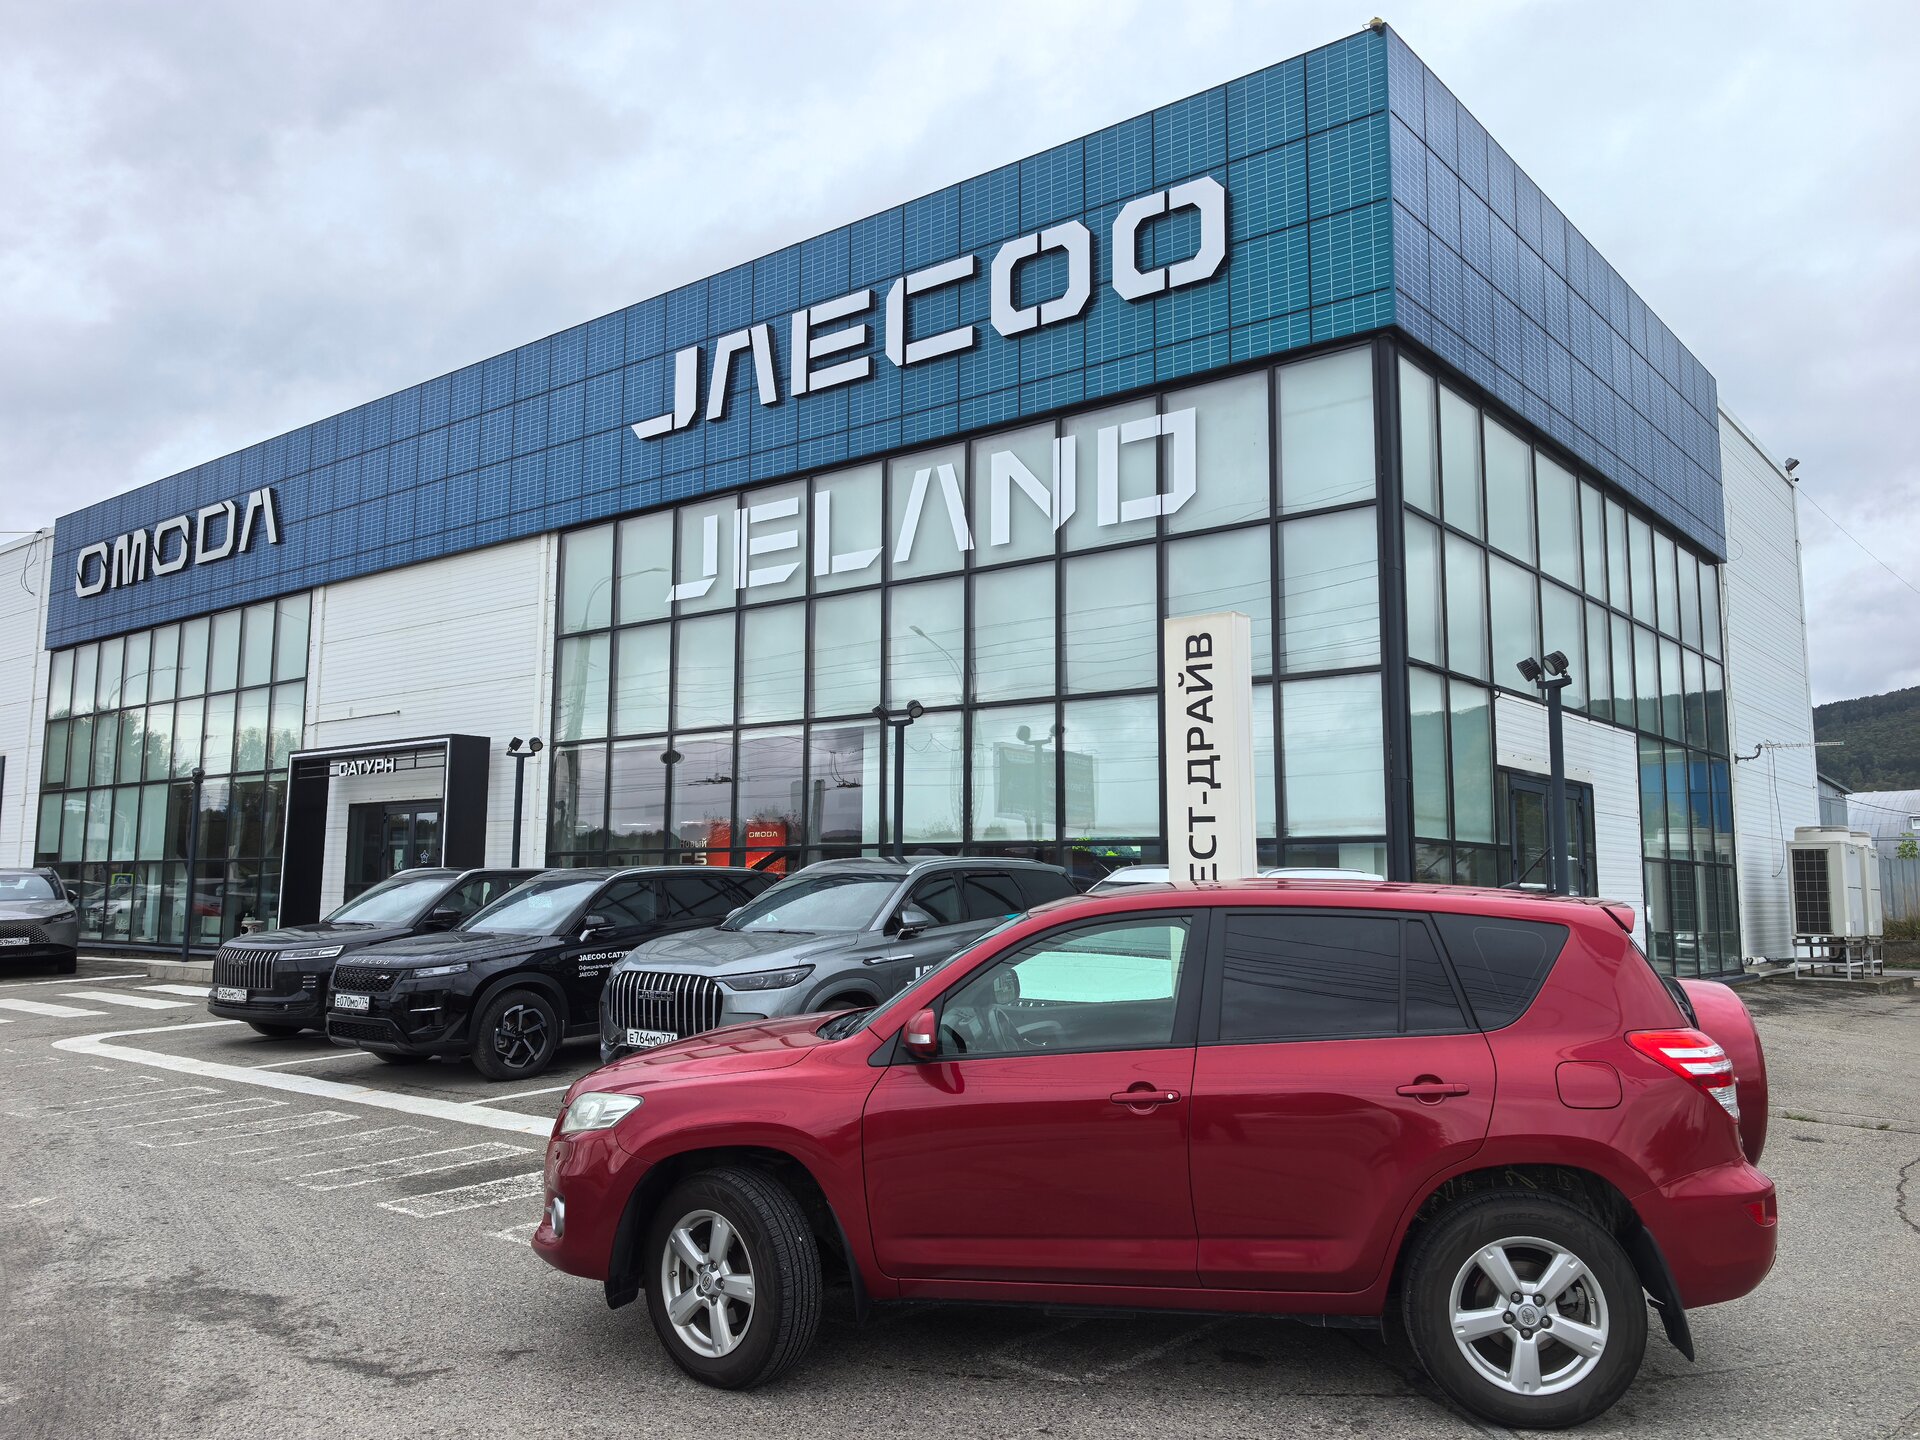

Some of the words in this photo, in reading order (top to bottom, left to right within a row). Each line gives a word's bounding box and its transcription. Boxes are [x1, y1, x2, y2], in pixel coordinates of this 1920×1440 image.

[631, 176, 1226, 440] JAECOO
[75, 487, 277, 598] OMODA
[665, 407, 1197, 602] JELAND
[338, 757, 395, 777] САТУРН
[1178, 631, 1222, 882] ЕСТ-ДРАЙВ
[578, 952, 607, 962] JAECOO
[607, 950, 632, 959] САТУР
[578, 970, 599, 978] JAECOO
